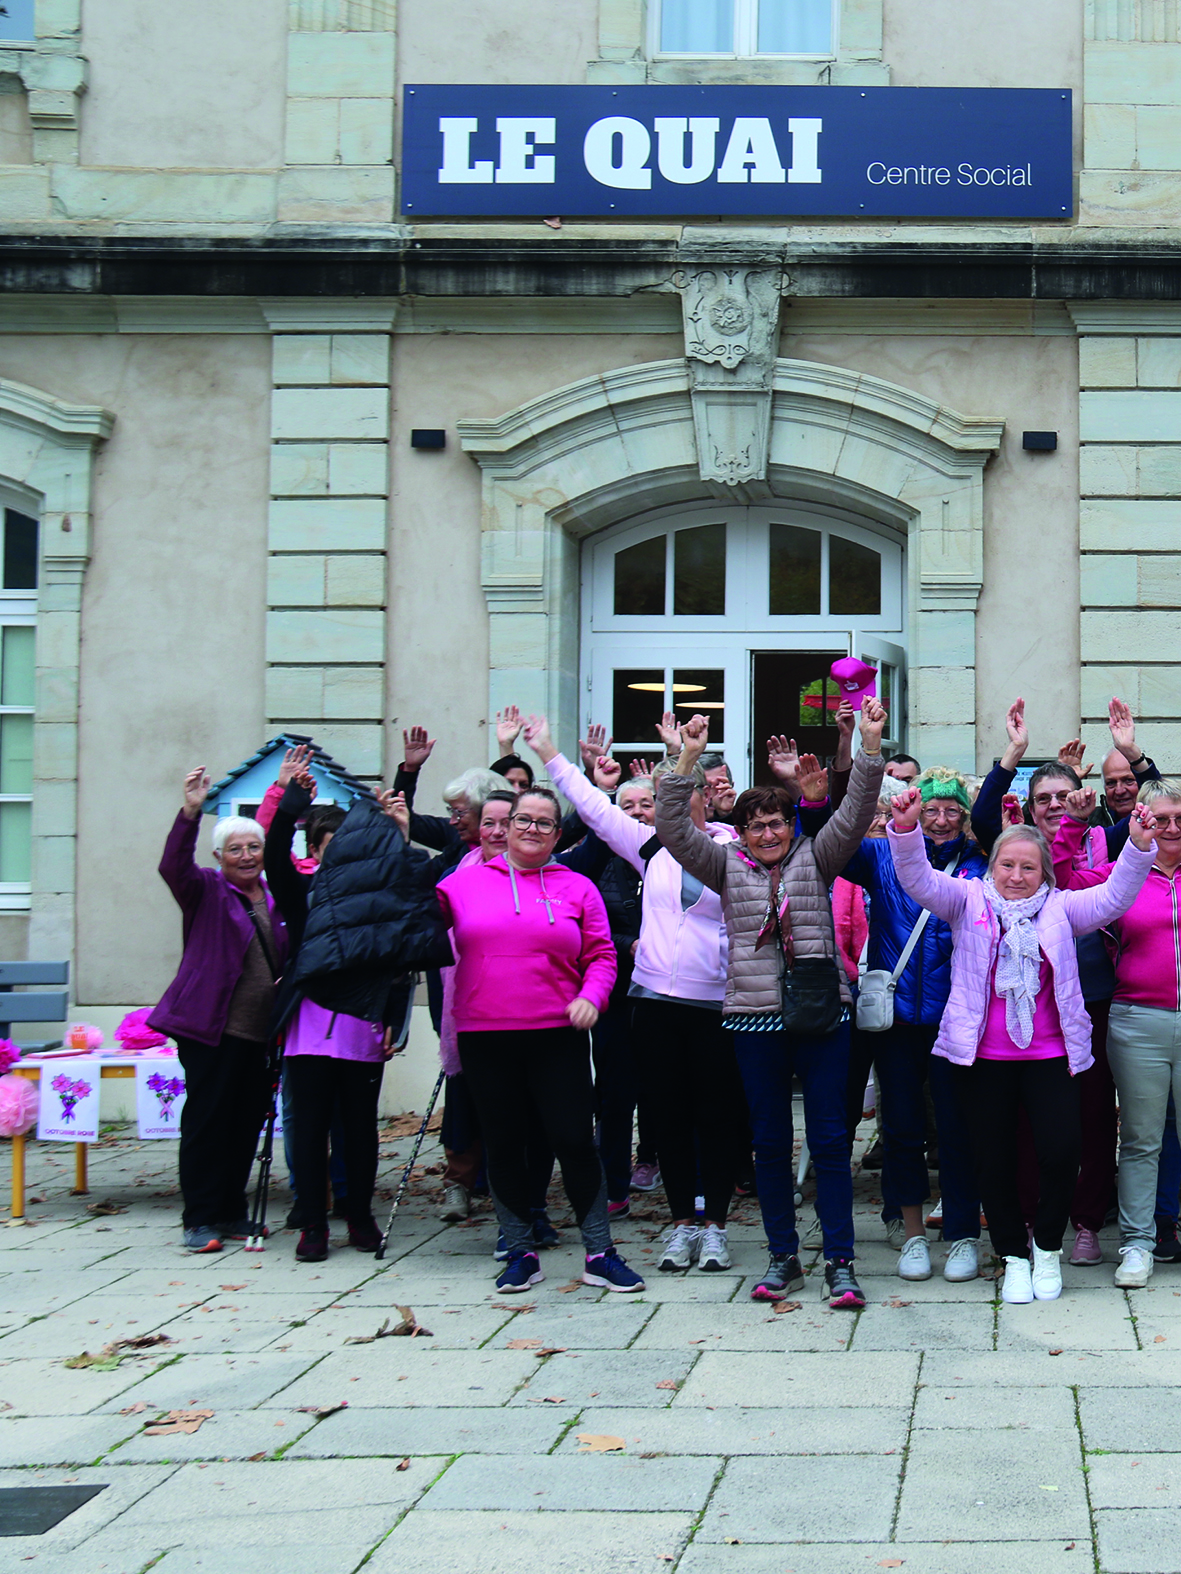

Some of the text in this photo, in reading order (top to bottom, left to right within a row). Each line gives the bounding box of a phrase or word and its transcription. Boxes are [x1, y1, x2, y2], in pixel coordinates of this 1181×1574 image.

[438, 116, 823, 190] LE QUAI
[866, 162, 1032, 186] Centre Social
[44, 1128, 76, 1136] OCTOBRE
